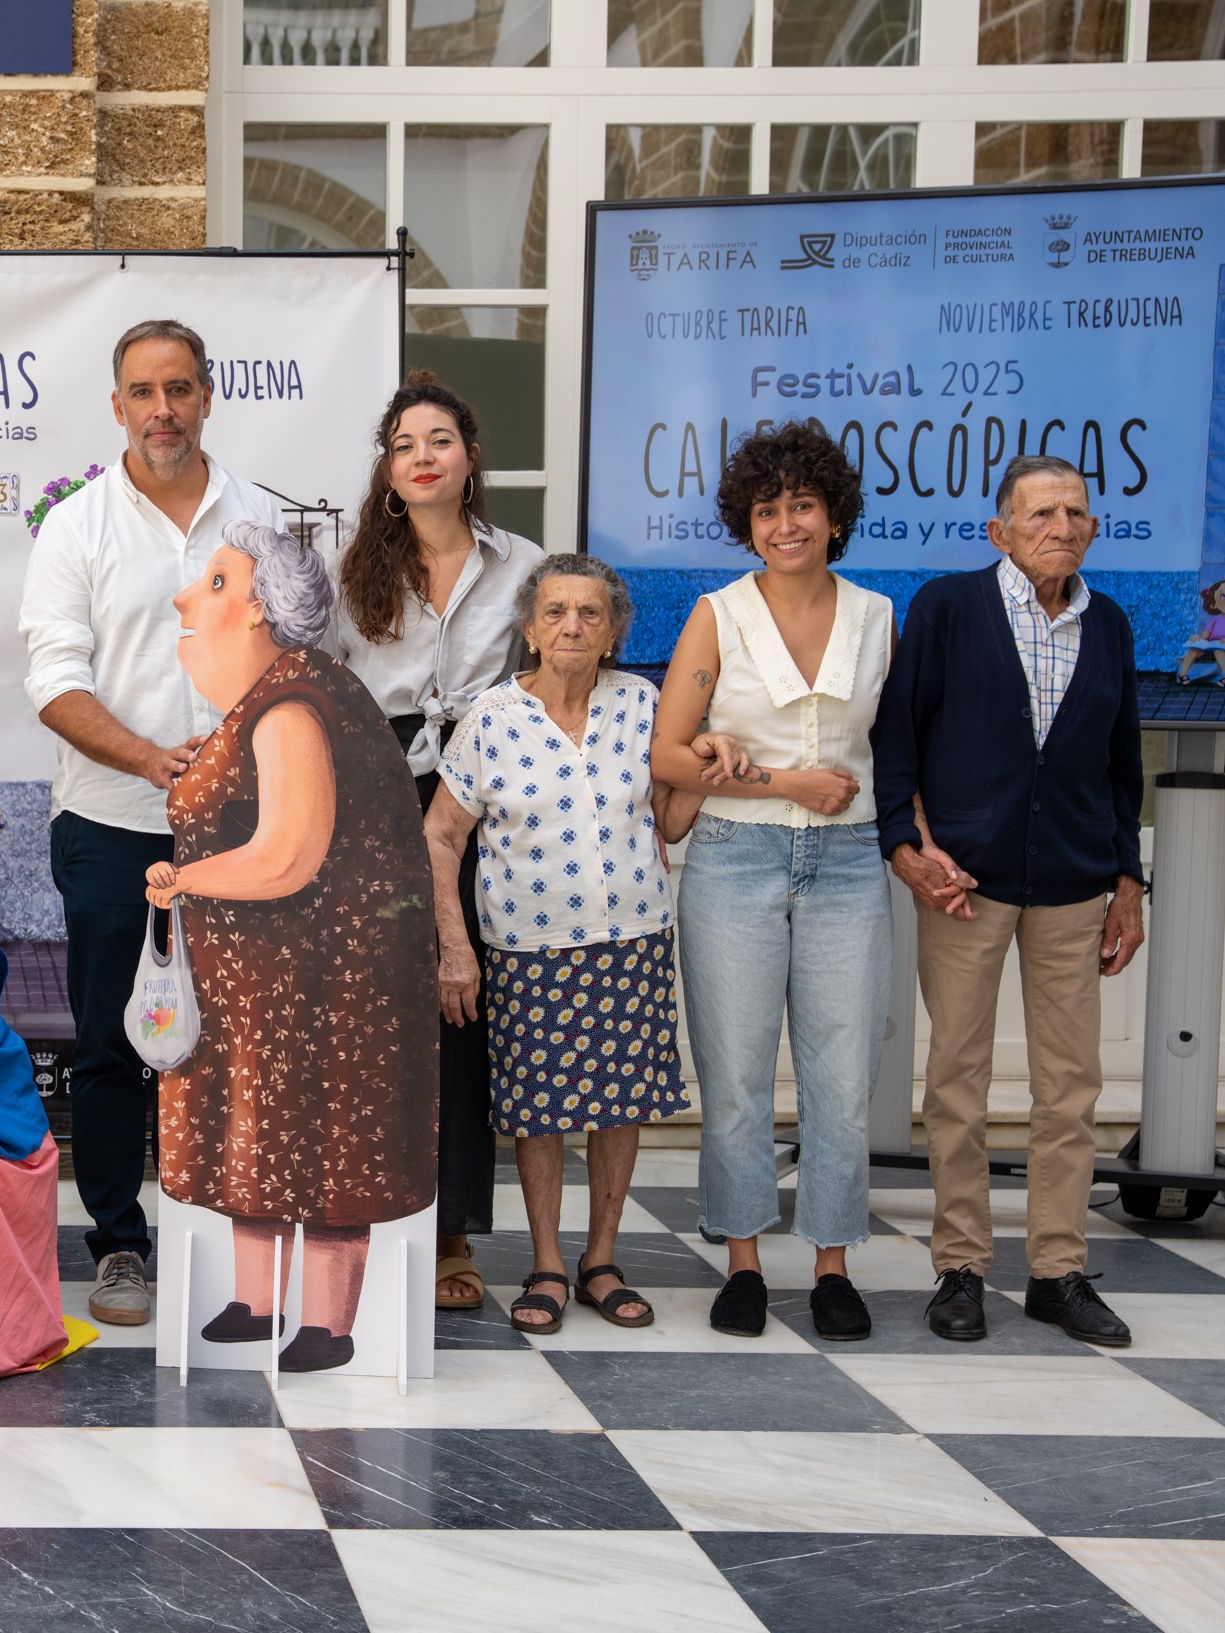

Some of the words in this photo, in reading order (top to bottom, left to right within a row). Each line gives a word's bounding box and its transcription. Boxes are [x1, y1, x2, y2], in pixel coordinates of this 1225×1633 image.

[843, 230, 926, 249] Diputación
[945, 226, 1012, 239] FUNDACIÓN
[1083, 226, 1204, 246] AYUNTAMIENTO
[944, 239, 1013, 251] PROVINCIAL
[1087, 249, 1107, 263] DE
[1110, 245, 1196, 264] TREBUJENA
[663, 250, 757, 271] TARIFA
[842, 253, 861, 269] de
[867, 252, 911, 268] Cádiz
[944, 254, 959, 264] DE
[962, 252, 1015, 264] CULTURA
[645, 309, 728, 340] OCTUBRE
[737, 305, 808, 337] TARIFA
[939, 300, 1053, 334] NOVIEMBRE
[1063, 296, 1183, 329] TREBUJENA
[750, 362, 924, 399] Festival
[940, 360, 1024, 396] 2025
[859, 514, 908, 540] ida
[918, 521, 935, 545] y
